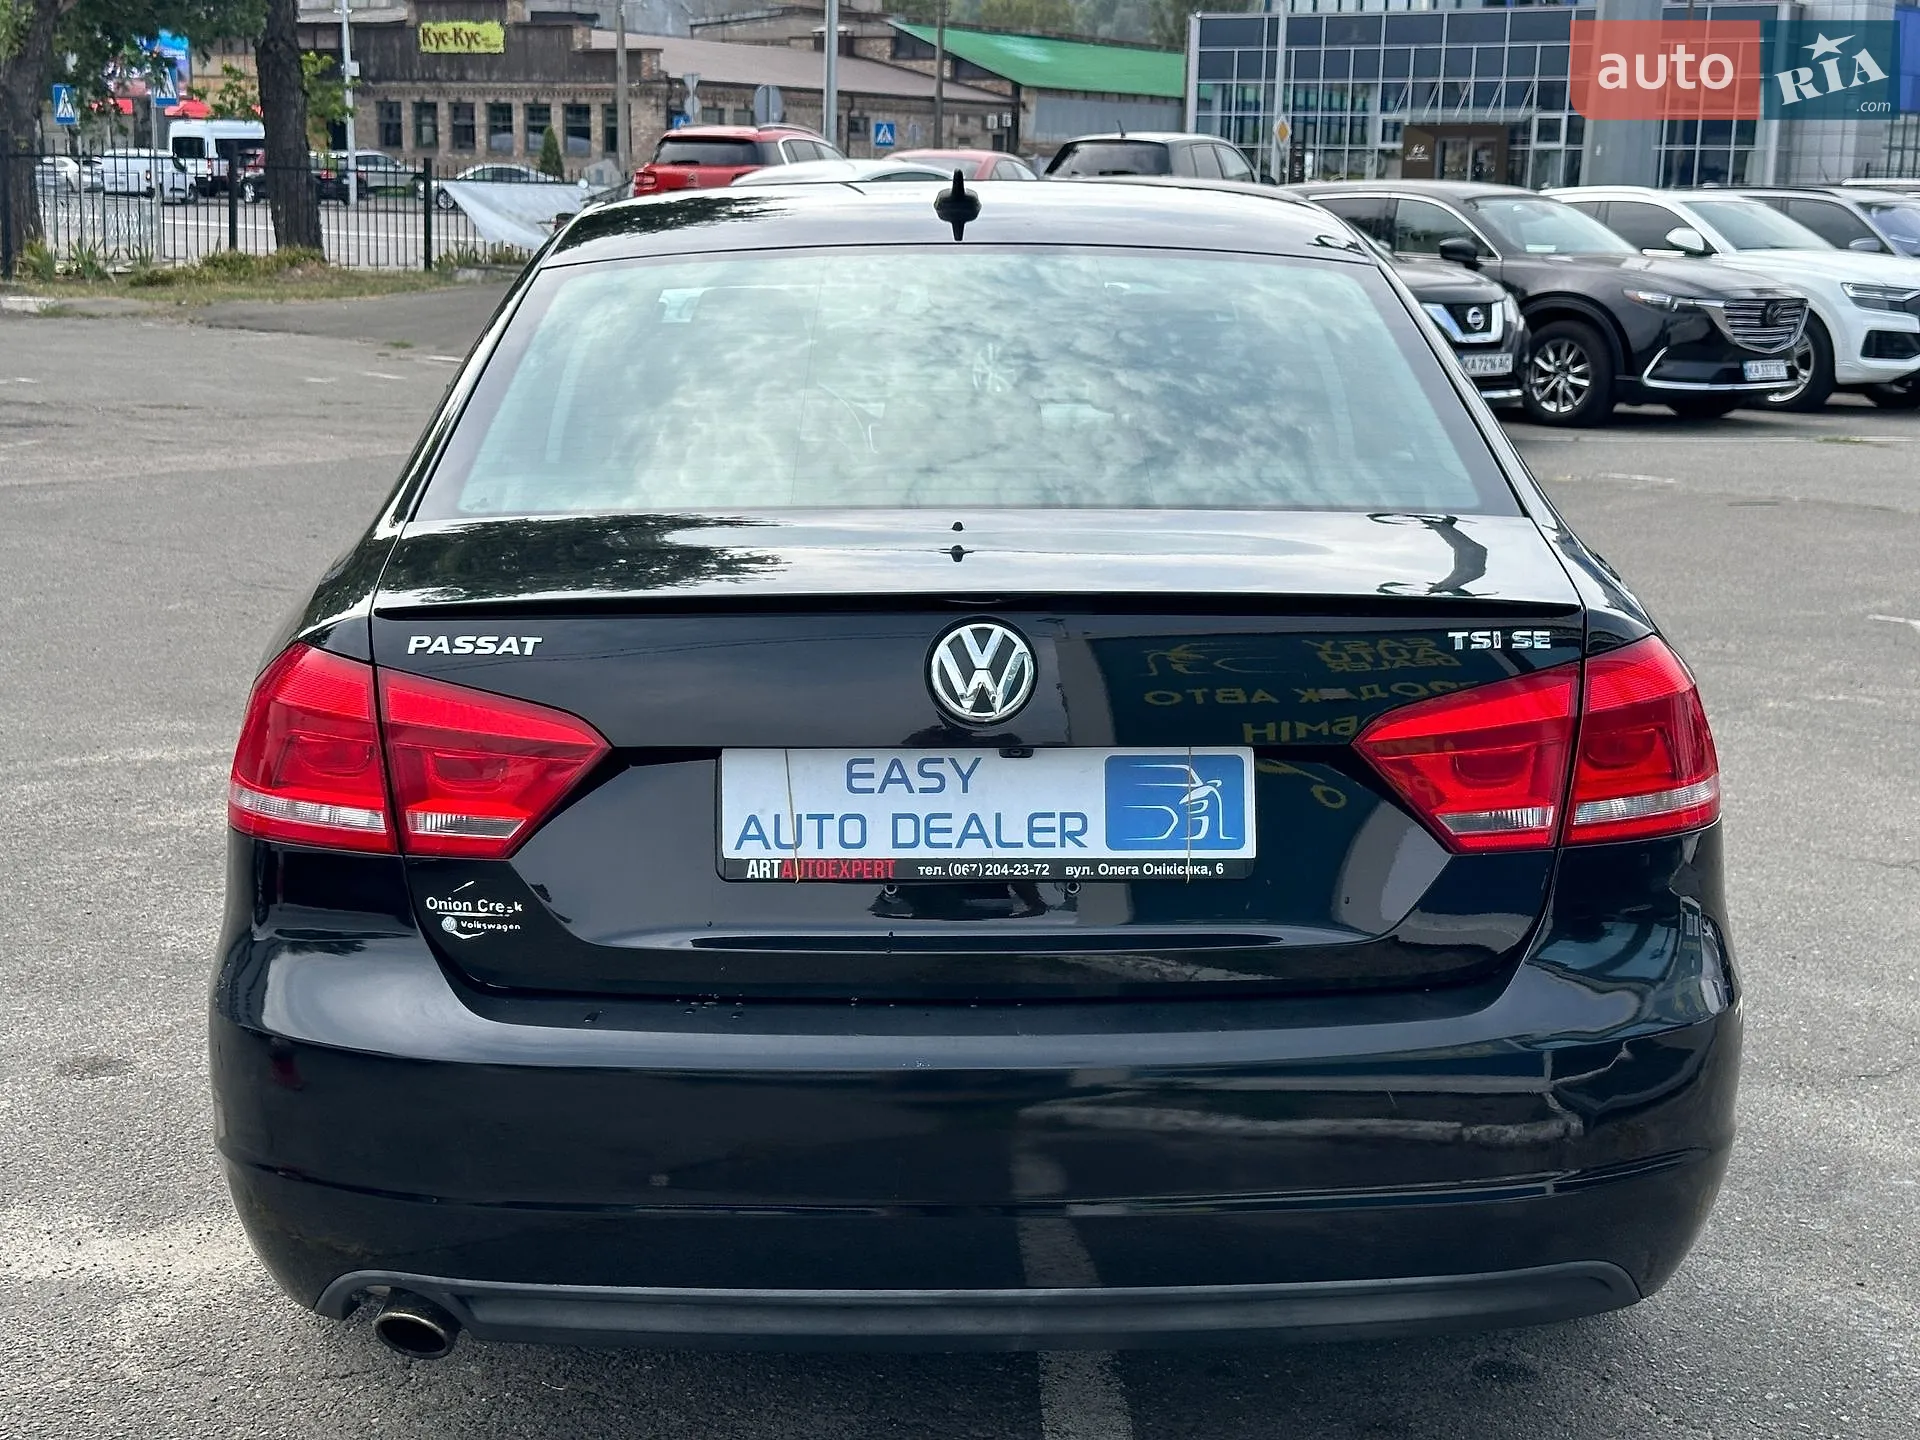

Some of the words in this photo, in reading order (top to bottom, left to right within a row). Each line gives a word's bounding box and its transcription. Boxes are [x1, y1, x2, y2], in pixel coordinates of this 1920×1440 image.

[421, 27, 480, 49] Кус-Кус
[407, 635, 543, 656] PASSAT
[1448, 630, 1502, 650] TSI
[1511, 630, 1552, 650] SE
[845, 757, 982, 795] EASY
[734, 813, 867, 850] AUTO
[891, 811, 1089, 849] DEALER
[917, 865, 946, 876] тел.
[984, 863, 1050, 876] 204-23-72
[1065, 865, 1094, 878] вул.
[1097, 863, 1139, 876] Олега
[1215, 862, 1224, 875] 6
[425, 896, 473, 912] Onion
[460, 920, 521, 932] Volkswagen
